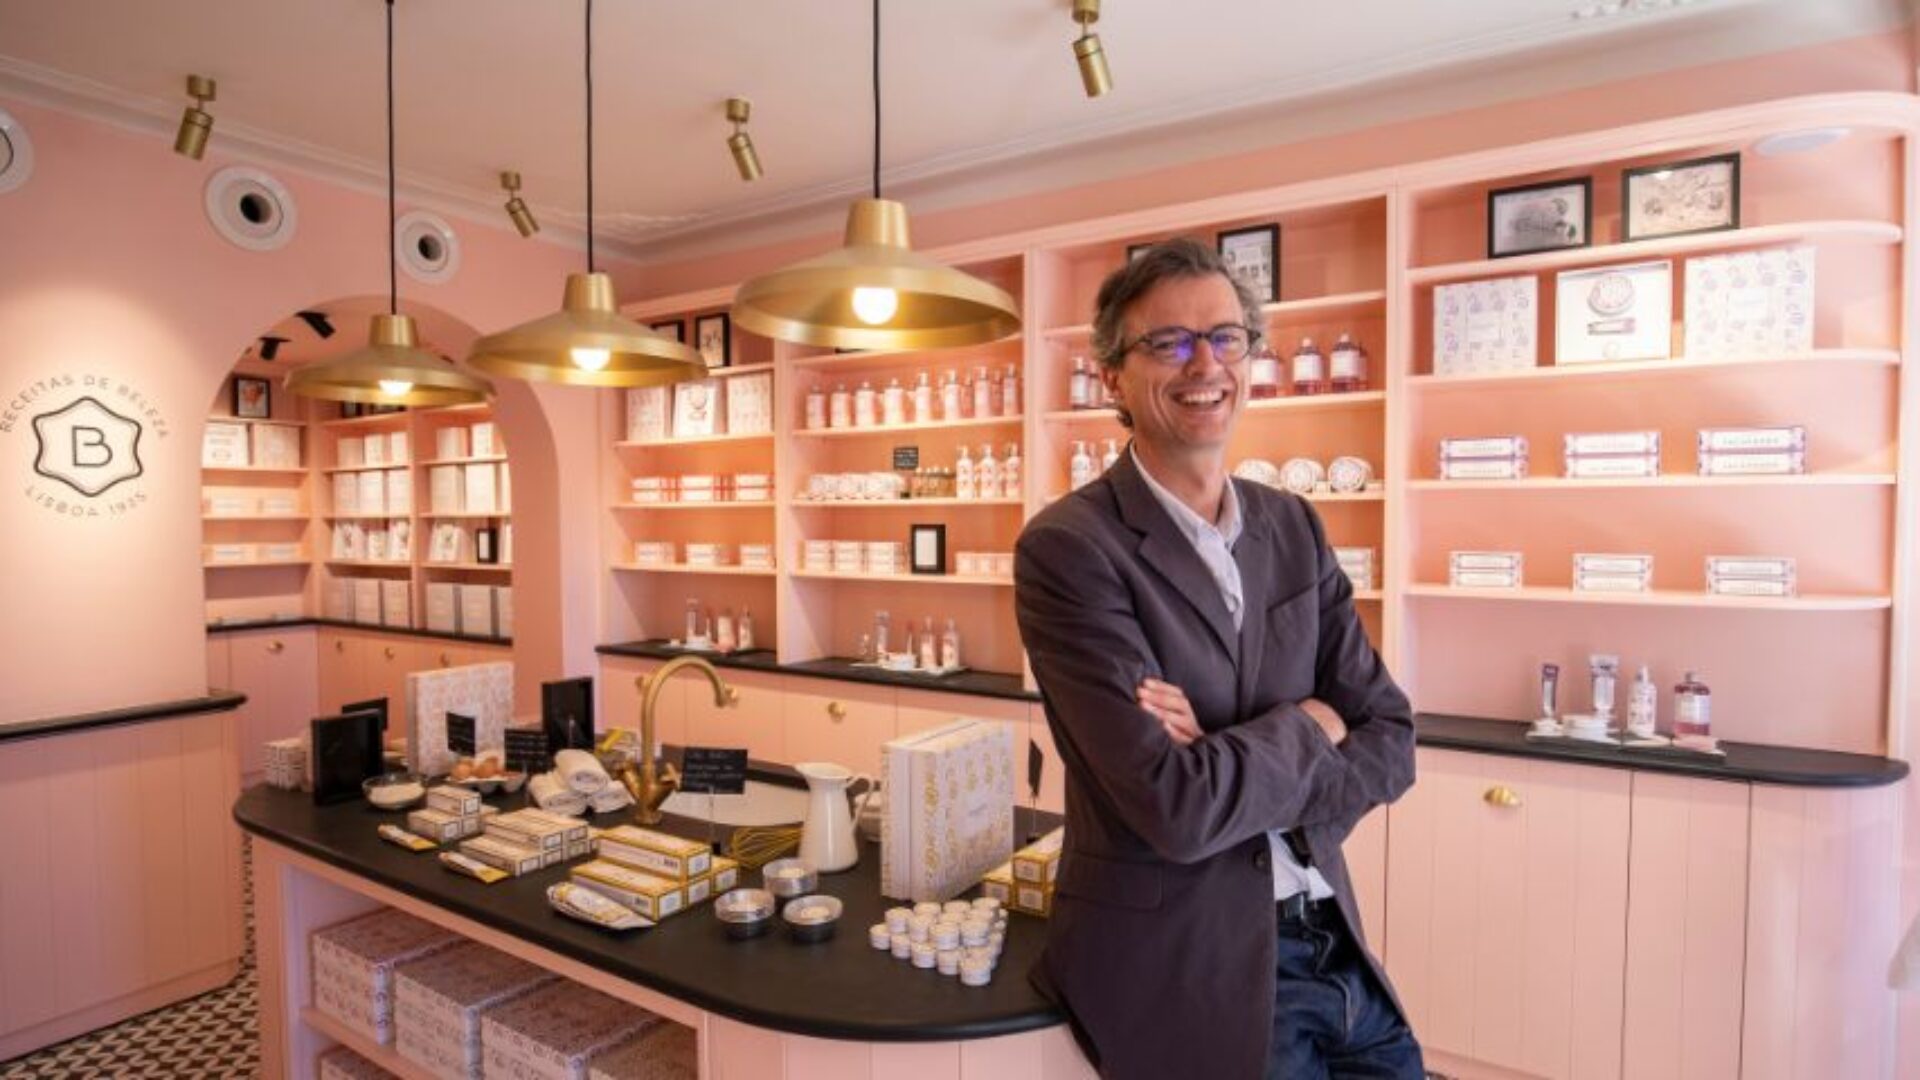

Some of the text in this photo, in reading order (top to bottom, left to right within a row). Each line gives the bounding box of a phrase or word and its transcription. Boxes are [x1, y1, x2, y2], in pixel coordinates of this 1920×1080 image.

[0, 375, 74, 432] RECEITAS
[84, 375, 109, 390] DE
[72, 425, 113, 467] B
[25, 486, 100, 517] LISBOA
